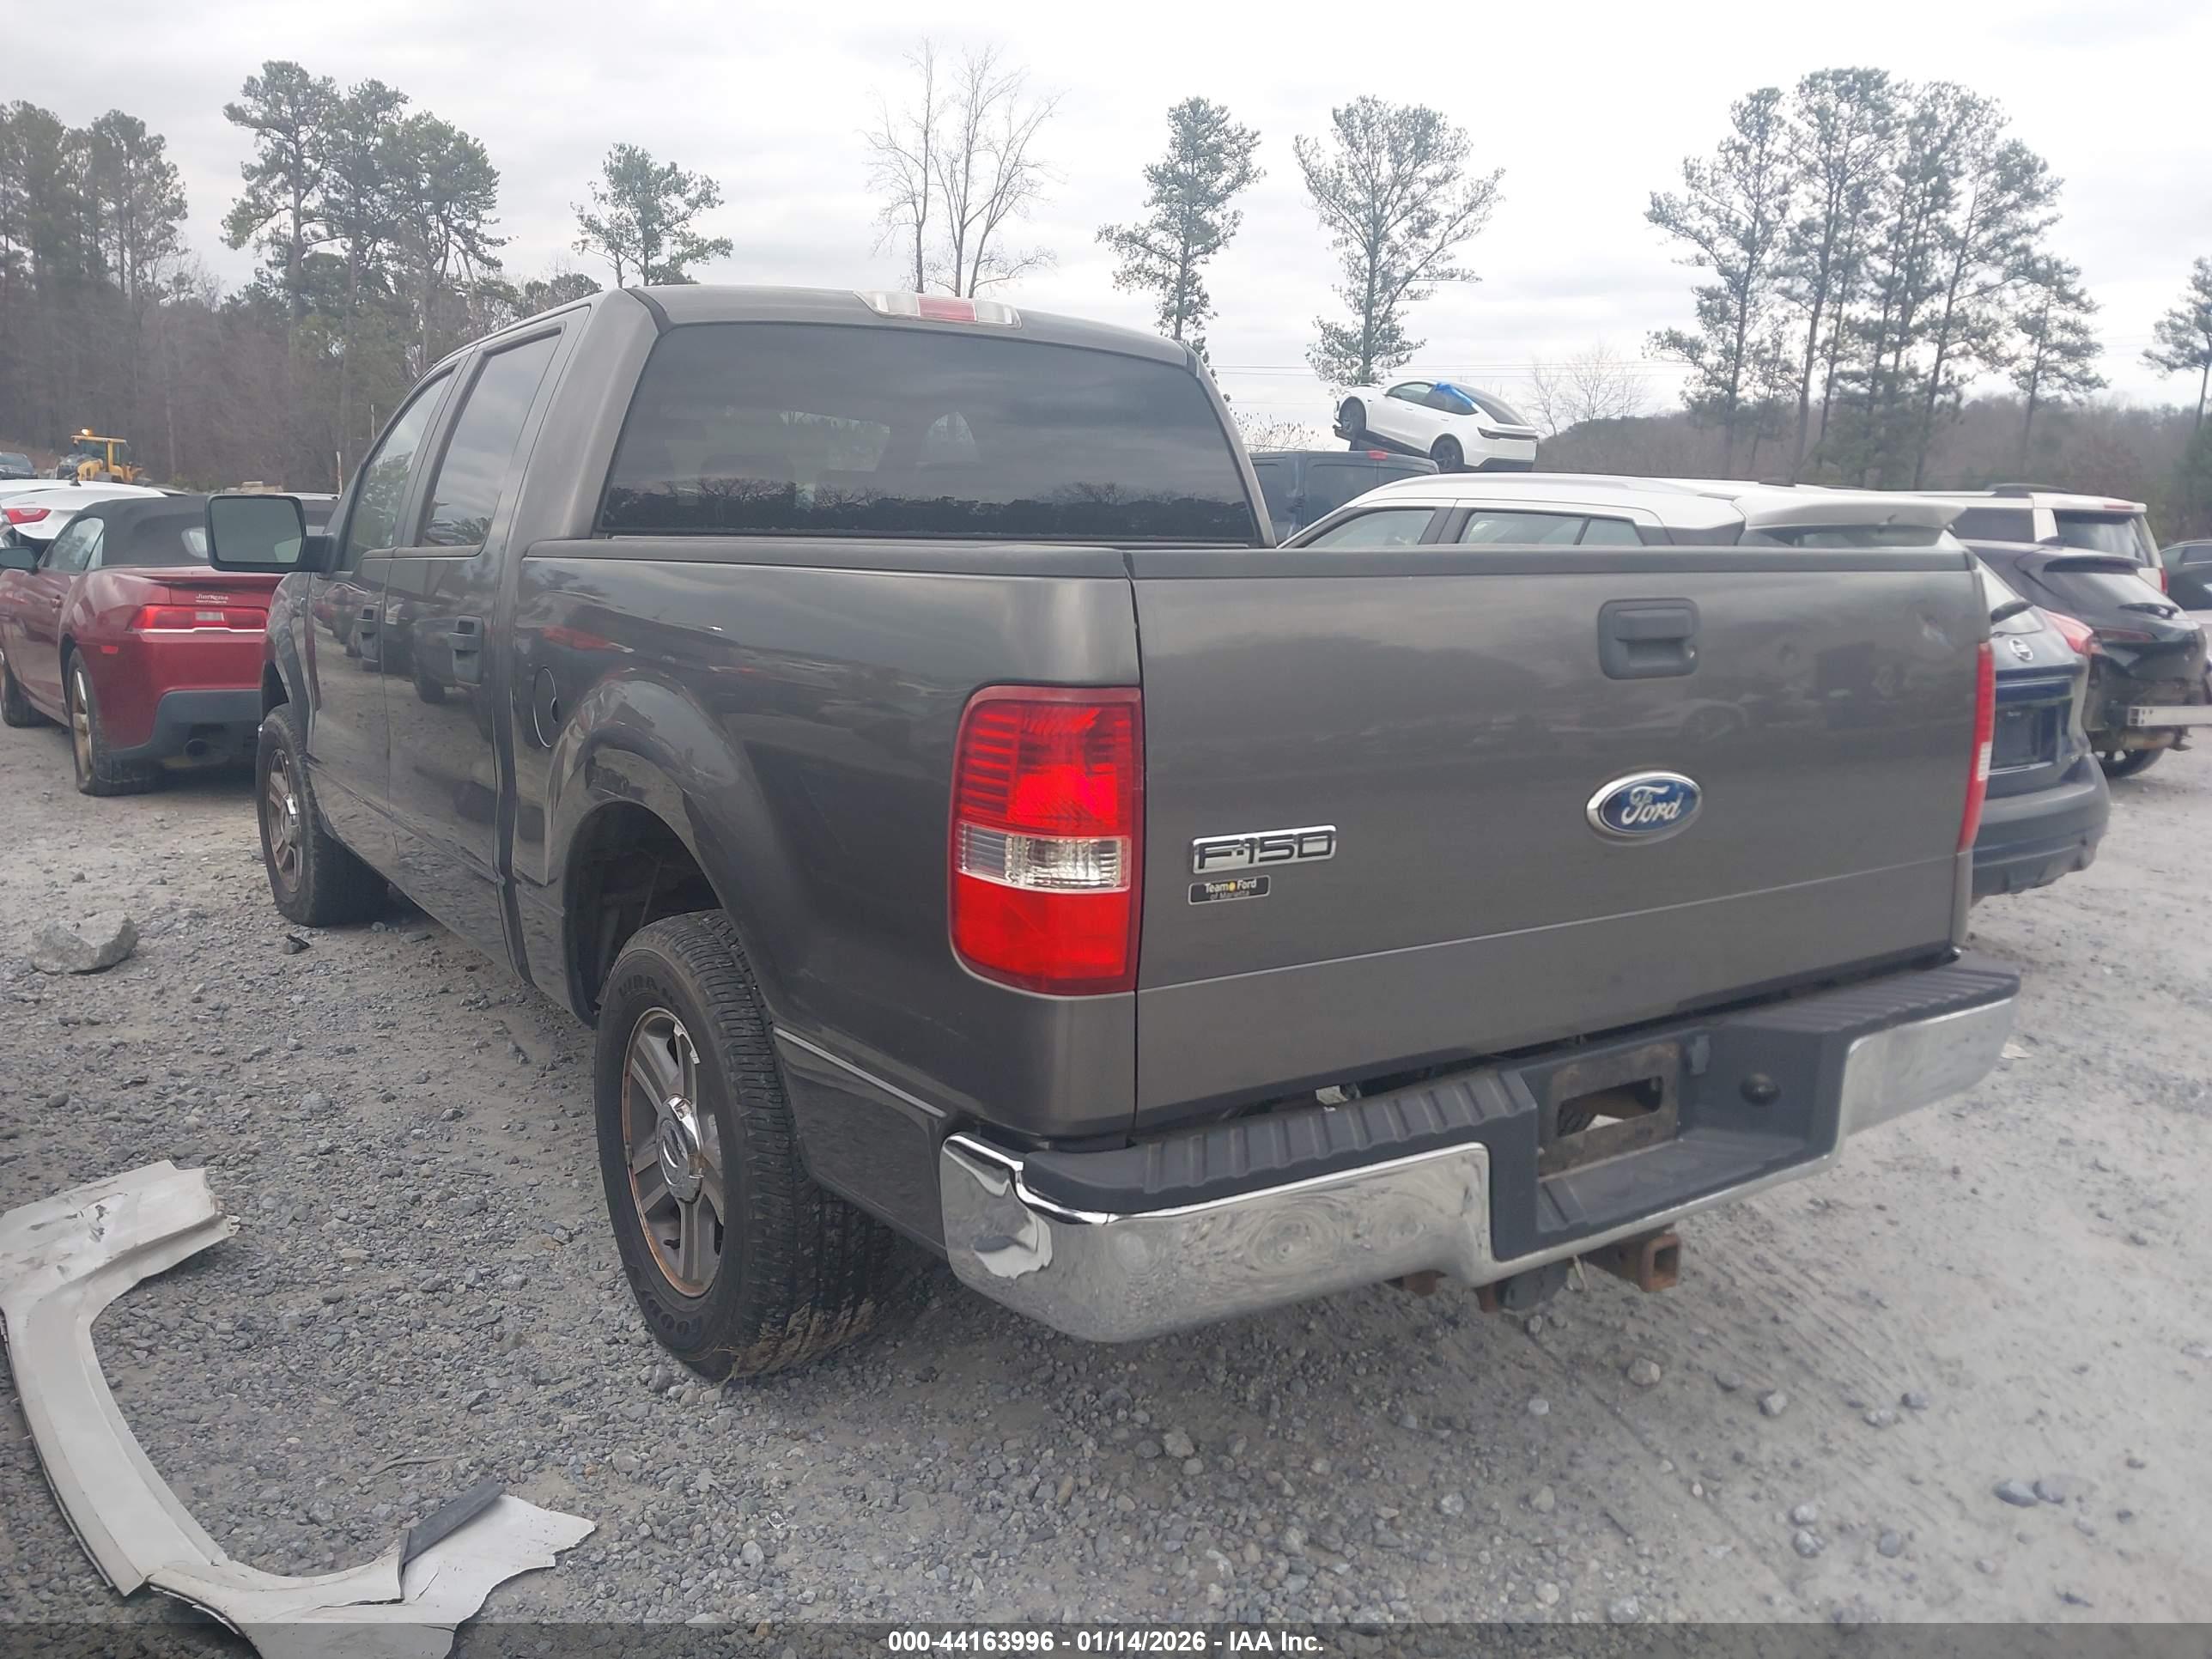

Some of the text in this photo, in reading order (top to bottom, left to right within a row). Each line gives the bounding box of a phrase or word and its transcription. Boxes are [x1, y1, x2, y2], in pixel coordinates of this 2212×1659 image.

[1621, 786, 1684, 825] Ford
[1197, 830, 1334, 870] F-150
[1205, 878, 1257, 894] Team Ford
